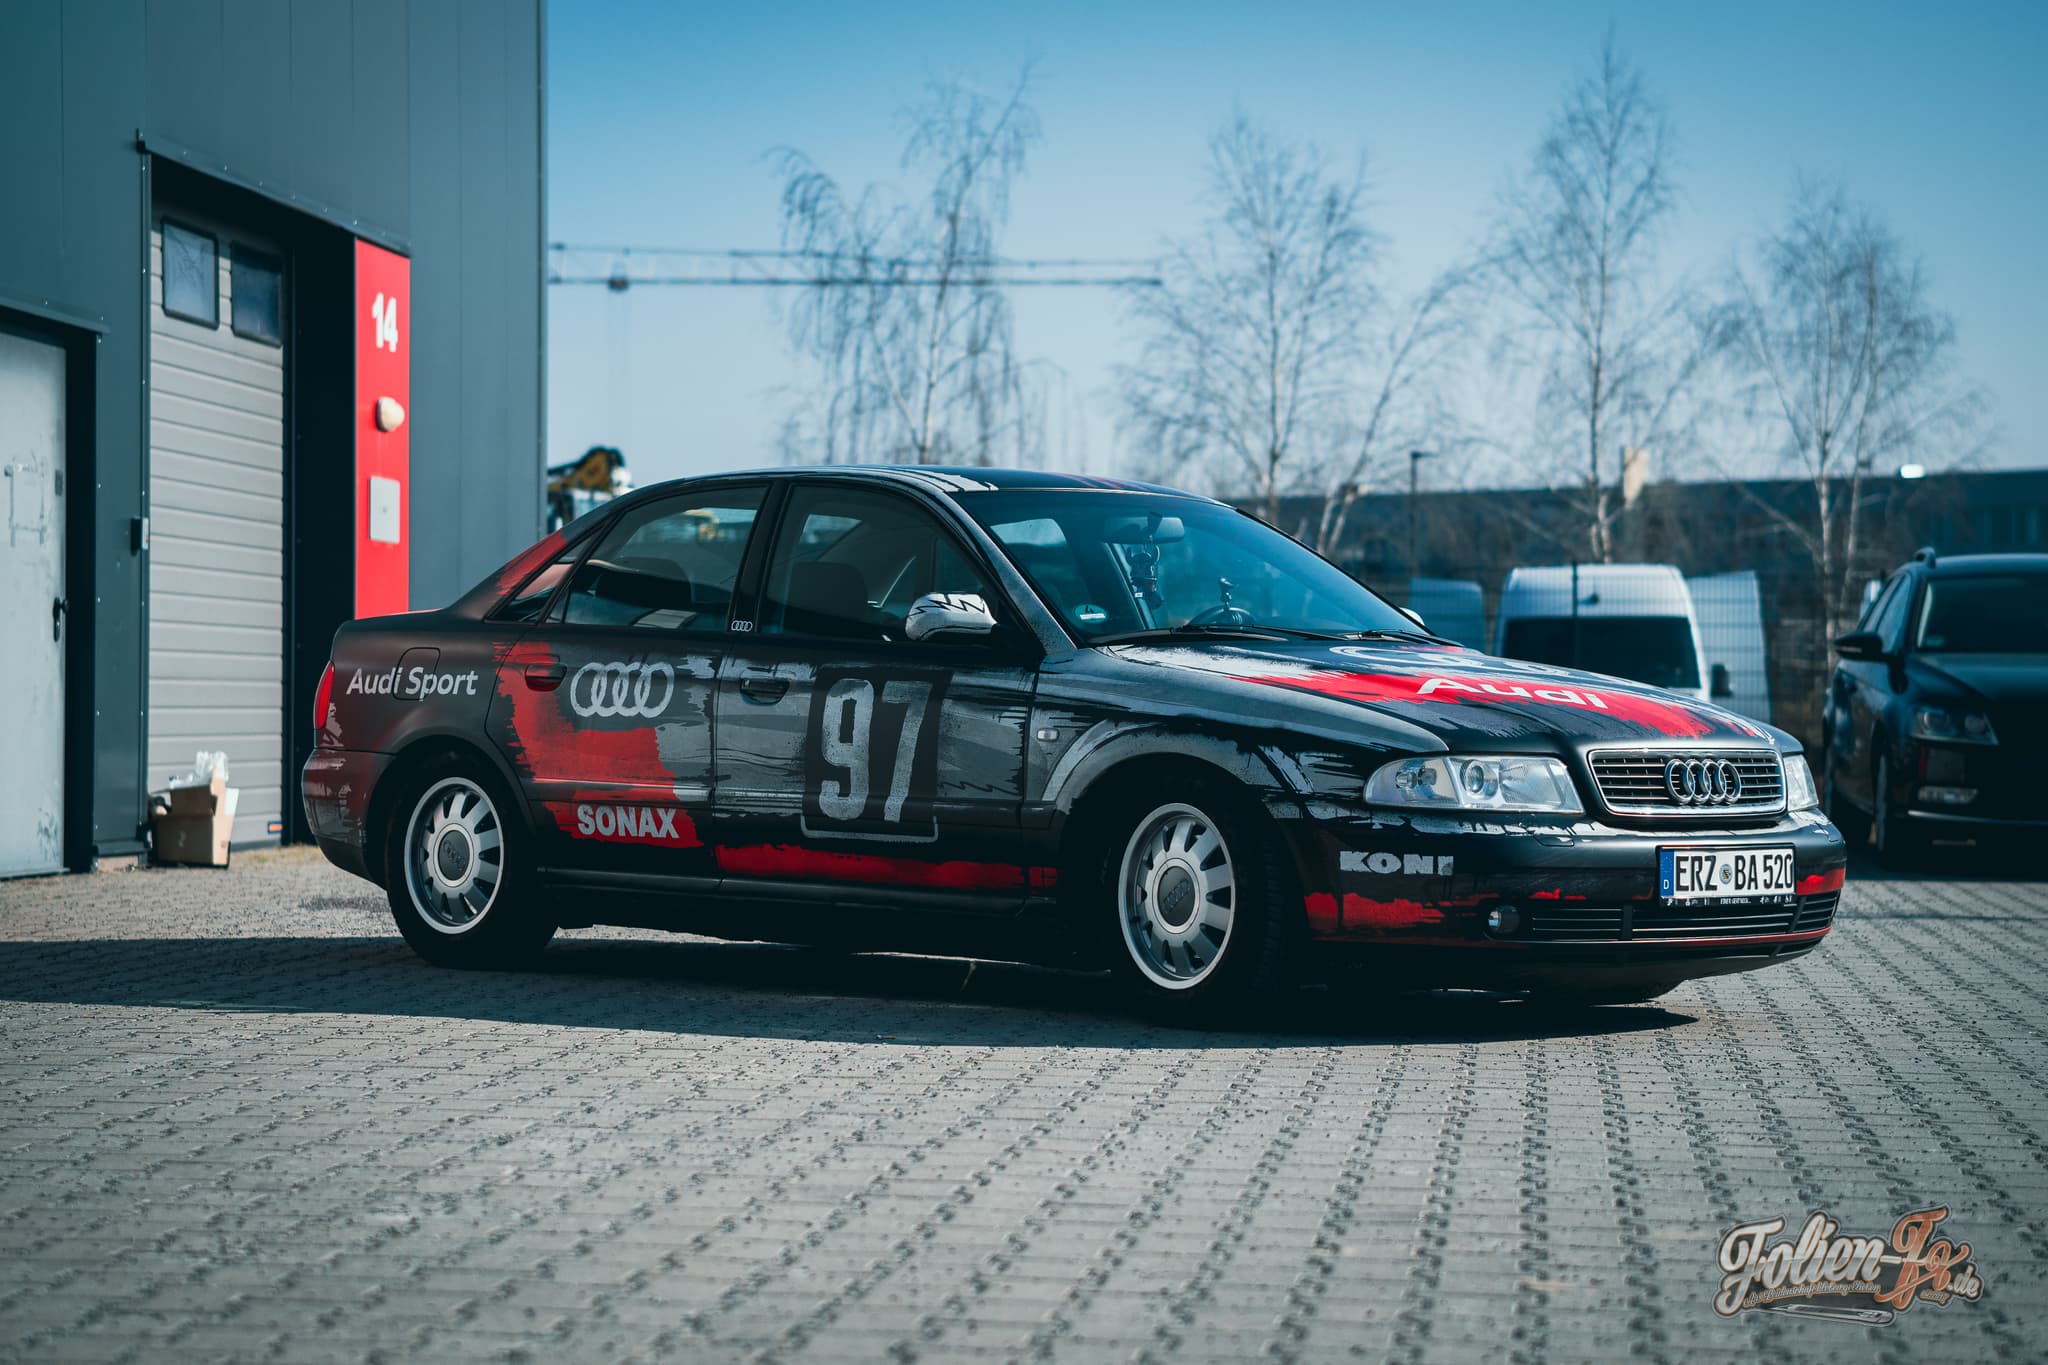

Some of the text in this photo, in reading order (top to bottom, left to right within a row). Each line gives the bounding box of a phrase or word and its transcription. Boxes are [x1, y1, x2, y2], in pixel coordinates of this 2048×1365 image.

[371, 292, 399, 352] 14
[345, 666, 479, 702] Audi Sport
[1417, 678, 1608, 710] Audi
[818, 678, 933, 823] 97
[577, 804, 680, 839] SONAX
[1340, 850, 1454, 876] KONI
[1675, 853, 1793, 892] ERZ BA 520
[1663, 879, 1670, 890] D
